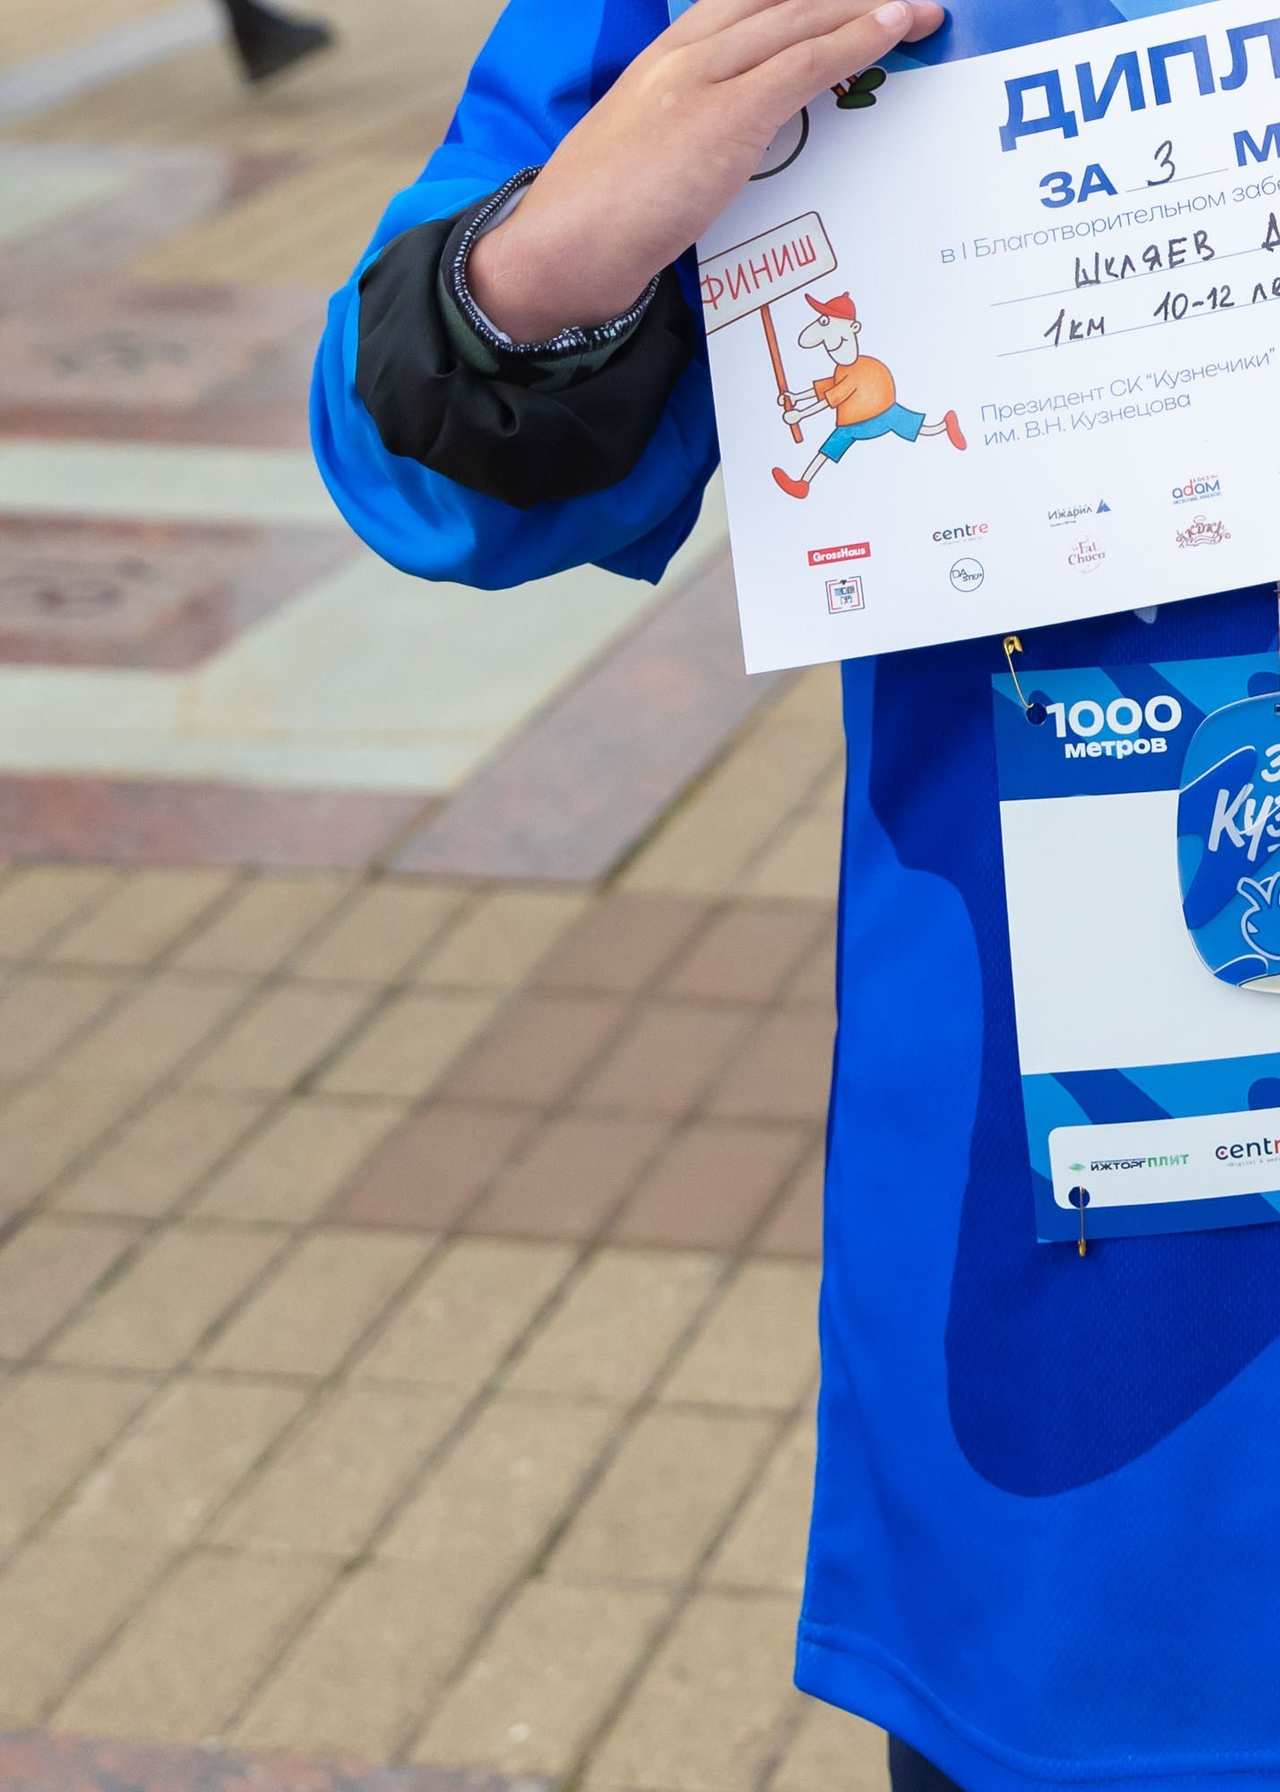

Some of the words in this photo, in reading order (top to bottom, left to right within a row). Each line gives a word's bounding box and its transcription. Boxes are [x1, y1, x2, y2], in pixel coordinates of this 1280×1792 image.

[1038, 162, 1119, 209] ЗА
[1145, 140, 1176, 187] 3
[973, 191, 1226, 258] Благотворительном
[701, 234, 817, 310] ФИНИШ
[1154, 284, 1235, 321] 10-12
[981, 386, 1105, 422] Президент
[1109, 375, 1143, 397] СК
[984, 429, 1020, 446] им.
[1024, 417, 1066, 439] В.Н.
[1071, 392, 1191, 430] Кузнецова
[812, 547, 866, 562] GrossHaus
[932, 523, 989, 542] centre
[1046, 694, 1182, 738] 1000
[1064, 737, 1168, 759] метров
